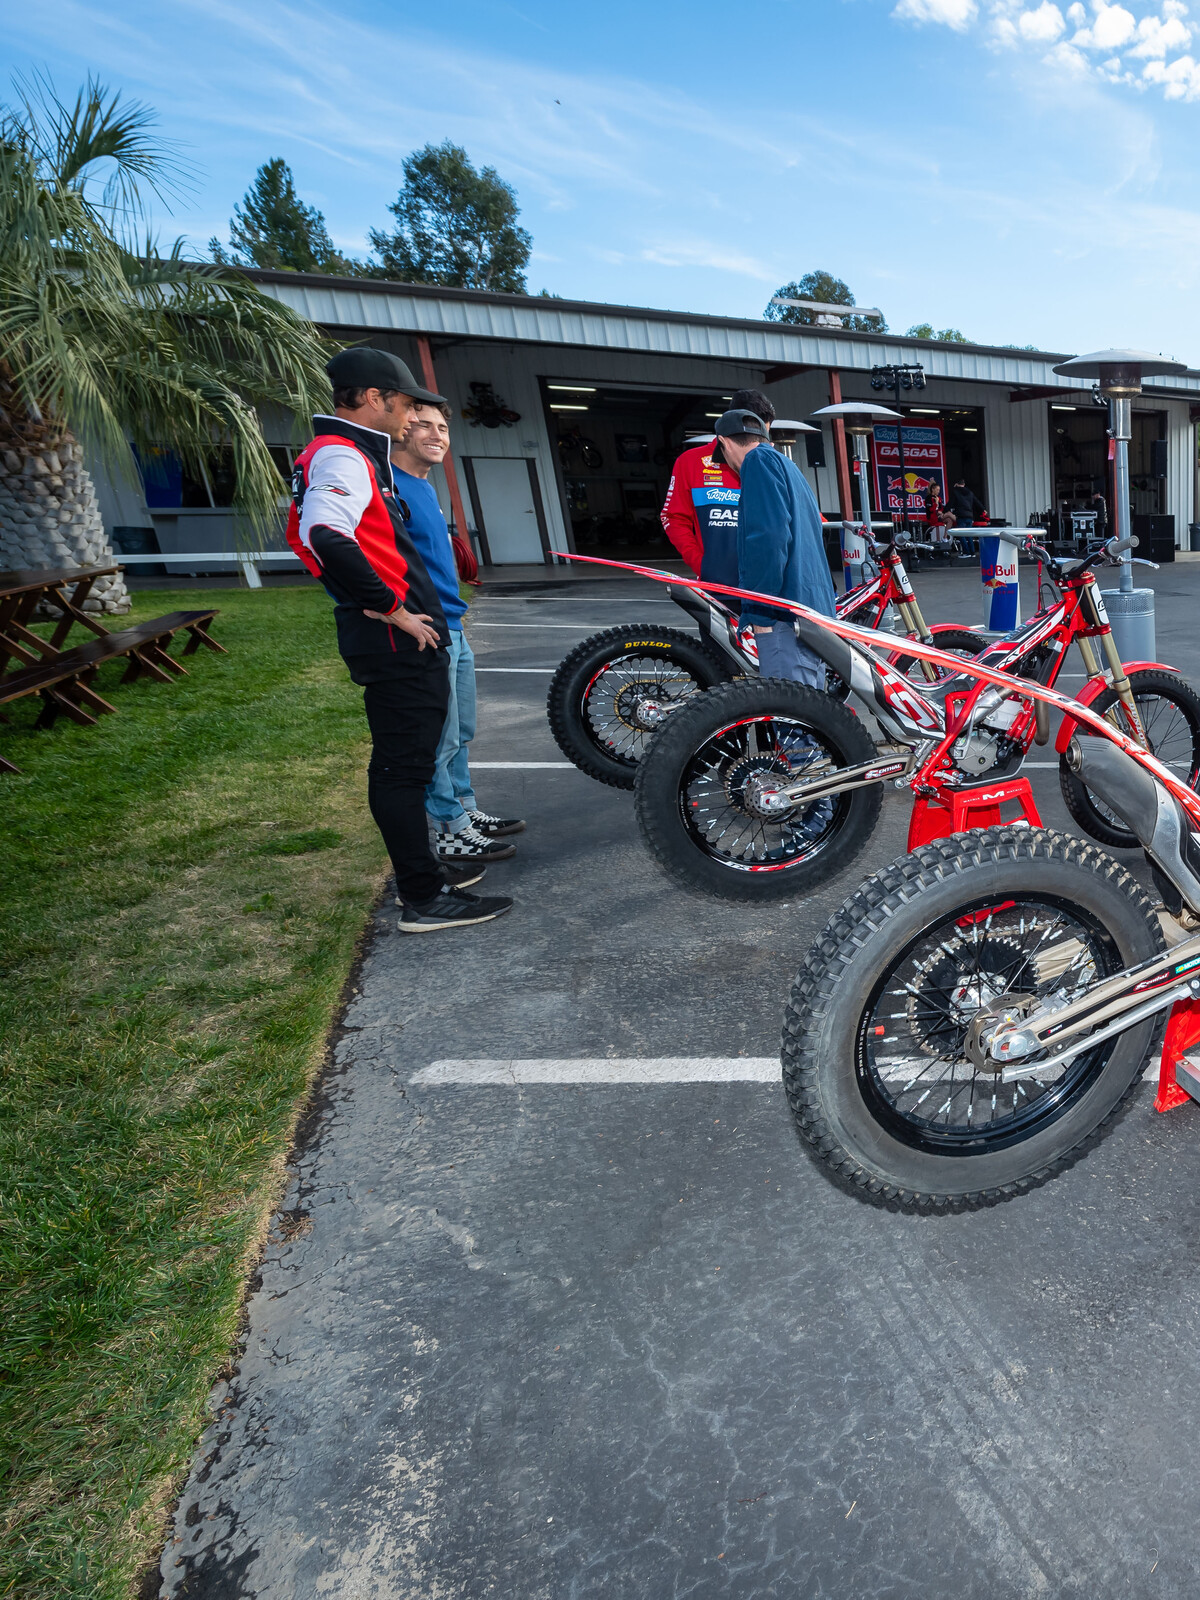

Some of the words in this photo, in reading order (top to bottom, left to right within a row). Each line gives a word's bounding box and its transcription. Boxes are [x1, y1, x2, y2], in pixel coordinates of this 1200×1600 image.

[880, 446, 938, 458] GASGAS
[706, 488, 725, 501] Troy
[724, 490, 740, 501] Lee
[888, 494, 913, 508] Red
[709, 508, 738, 520] GAS
[843, 550, 860, 559] Bull
[981, 565, 994, 577] ed
[995, 564, 1016, 577] Bull
[624, 640, 672, 650] DUNLOP
